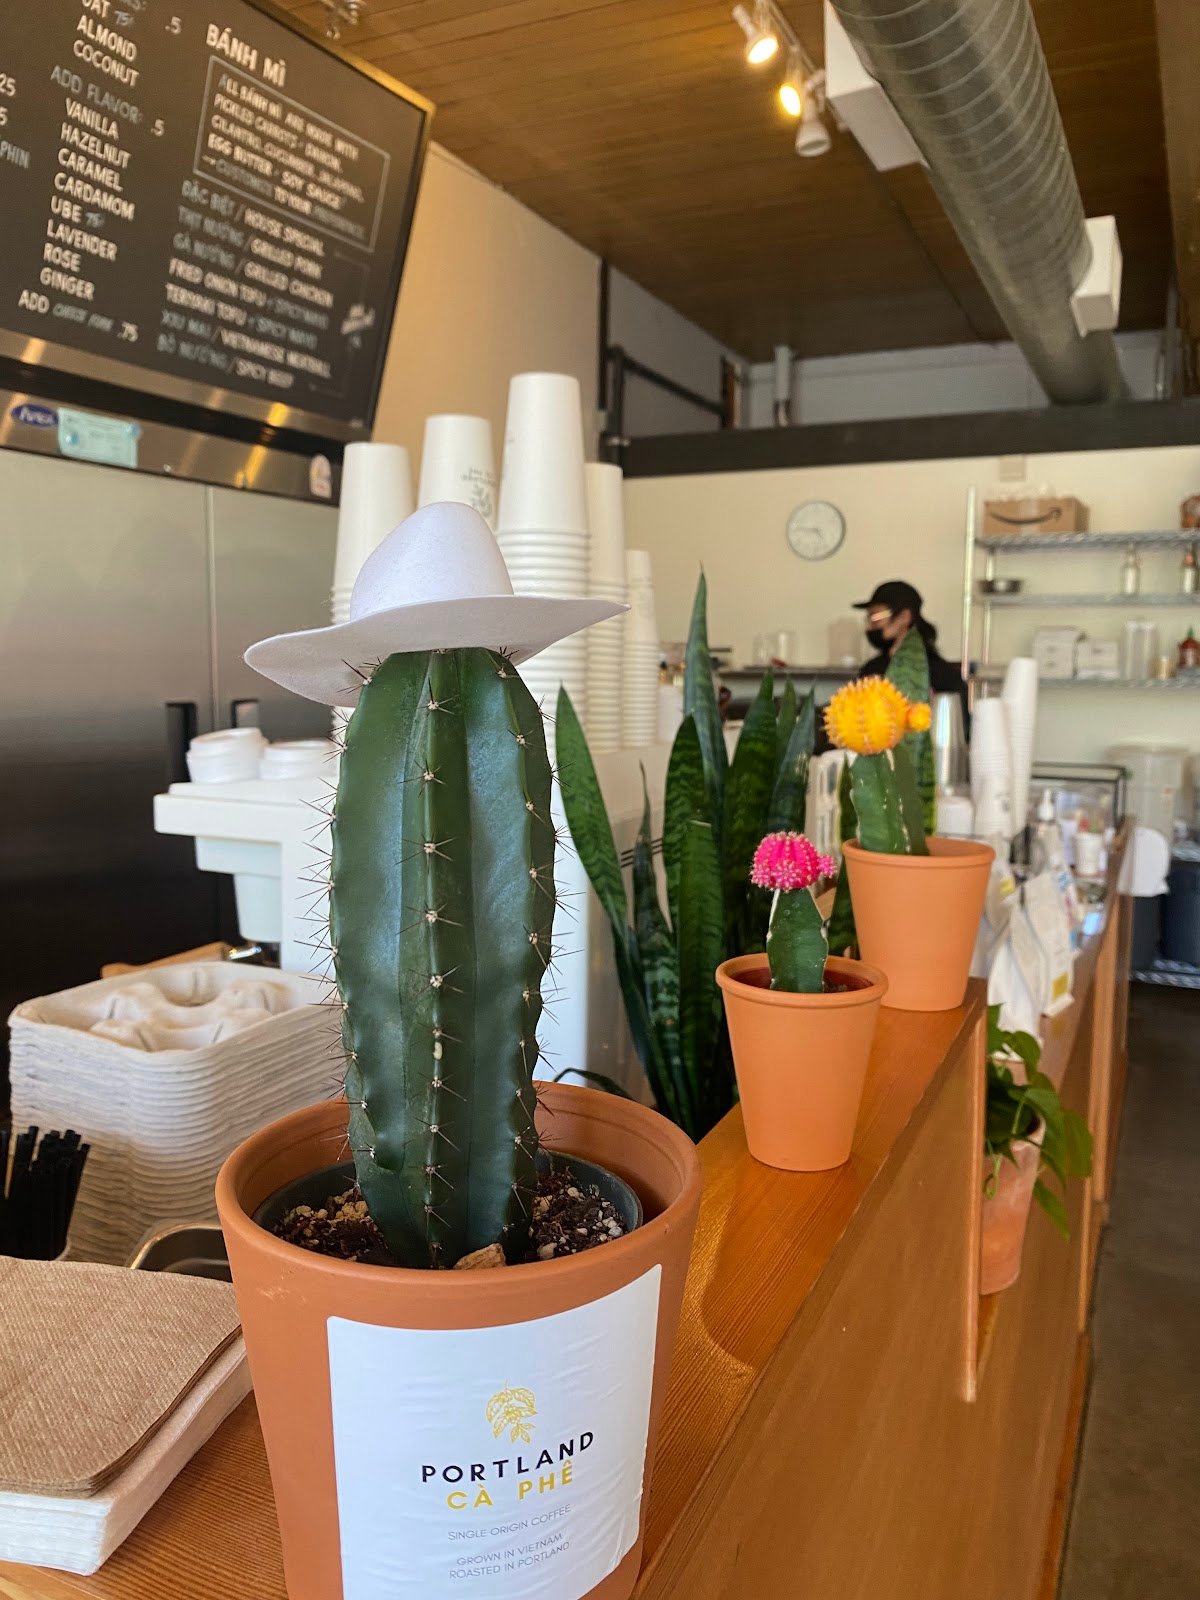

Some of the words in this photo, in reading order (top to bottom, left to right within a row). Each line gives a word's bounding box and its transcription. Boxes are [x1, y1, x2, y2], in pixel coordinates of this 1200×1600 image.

[77, 14, 137, 62] ALMOND
[206, 23, 258, 70] BÁNH
[263, 57, 286, 87] MÌ
[50, 65, 83, 94] ADD
[73, 39, 139, 87] COCONUT
[65, 97, 119, 140] VANILLA
[61, 122, 131, 169] HAZELNUT
[58, 147, 124, 192] CARAMEL
[50, 195, 82, 223] UBE
[54, 172, 136, 221] CARDAMOM
[43, 242, 82, 272] ROSE
[46, 219, 118, 261] LAVENDER
[18, 289, 50, 314] ADD
[40, 267, 95, 301] GINGER
[421, 1431, 594, 1483] PORTLAND
[446, 1483, 494, 1510] CÀ
[518, 1459, 574, 1501] PHÊ
[447, 1529, 487, 1541] SINGLE
[489, 1519, 529, 1537] ORIGIN
[530, 1503, 572, 1527] COFFEE
[449, 1564, 502, 1580] ROASTED
[503, 1559, 516, 1572] IN
[517, 1541, 571, 1568] PORTLAND
[456, 1551, 502, 1567] GROWN
[503, 1549, 516, 1559] IN
[517, 1532, 563, 1556] VIETNAM
